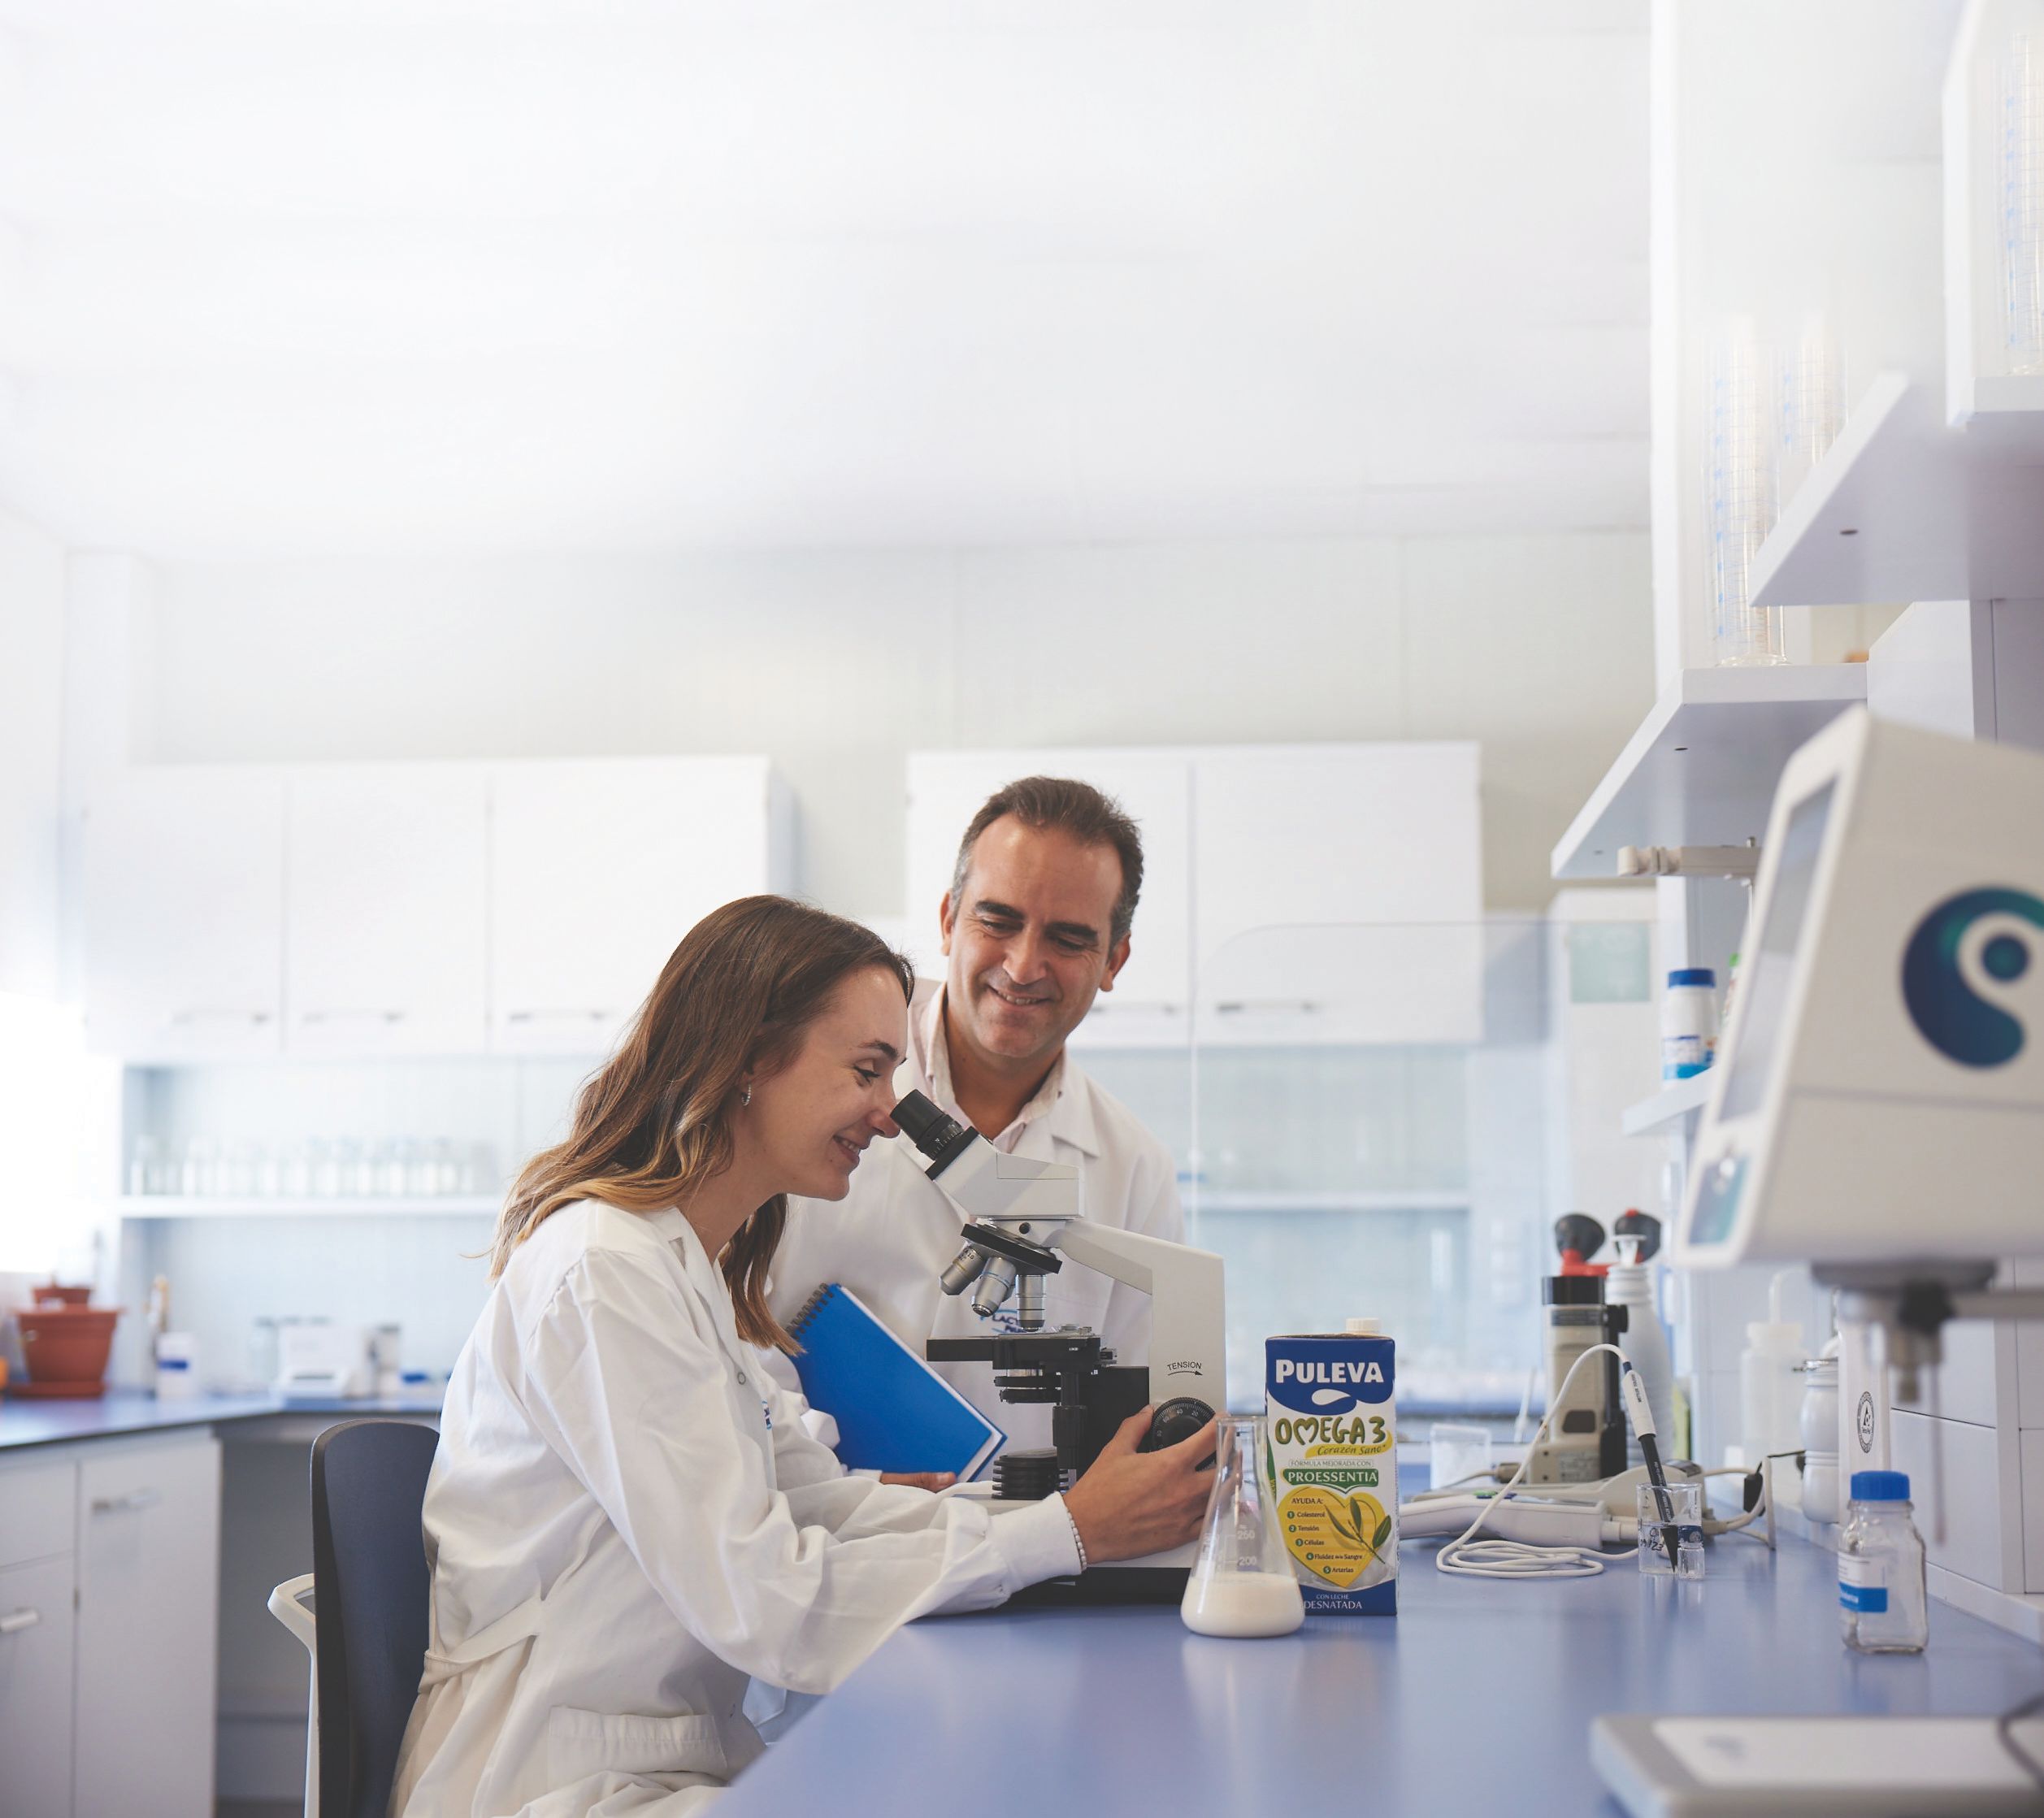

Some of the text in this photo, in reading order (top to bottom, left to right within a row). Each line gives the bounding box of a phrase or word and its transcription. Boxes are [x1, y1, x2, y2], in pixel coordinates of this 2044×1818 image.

[1167, 1361, 1202, 1371] TENSION
[1275, 1359, 1384, 1383] PULEVA
[1274, 1416, 1387, 1446] OMEGA 3
[1239, 1555, 1256, 1566] 200
[1304, 1601, 1363, 1609] DESNATADA
